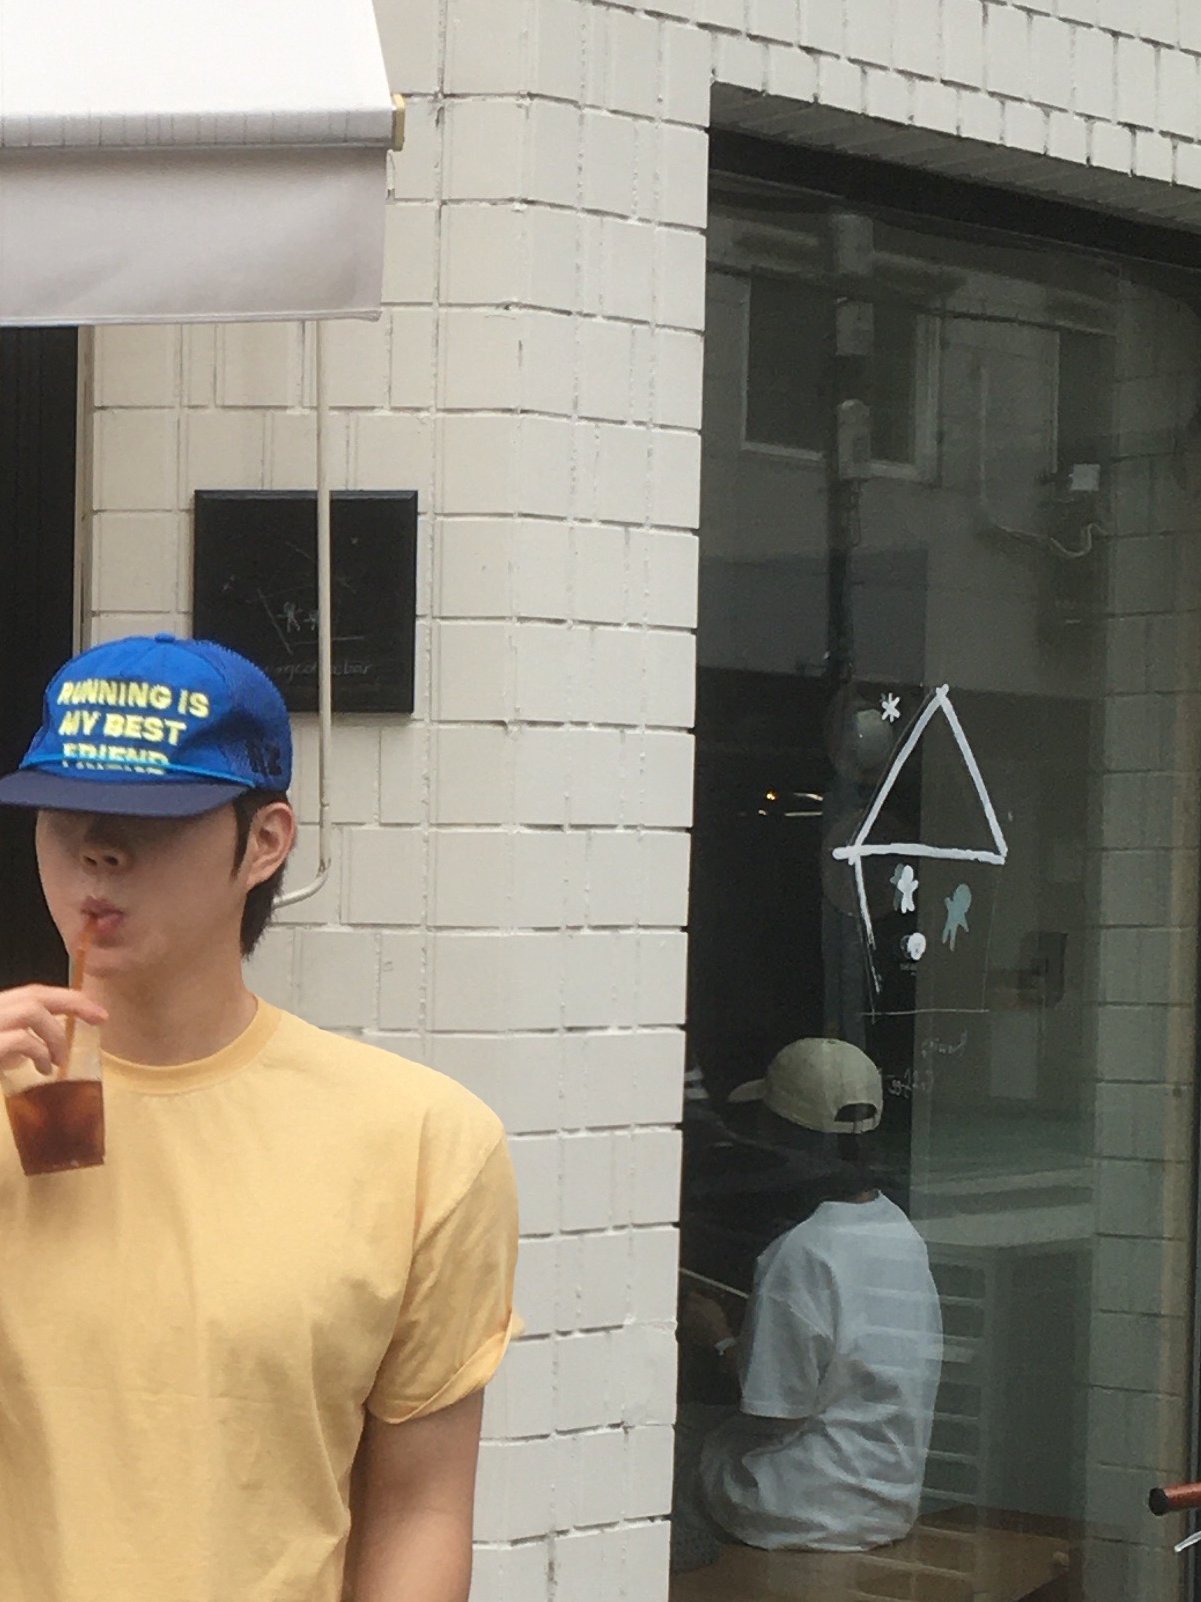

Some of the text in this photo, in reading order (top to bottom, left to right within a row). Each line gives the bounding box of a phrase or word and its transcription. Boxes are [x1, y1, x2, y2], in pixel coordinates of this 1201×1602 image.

[56, 677, 210, 719] RUNNING IS
[58, 709, 187, 747] MY BEST
[61, 743, 171, 776] FRIEND
